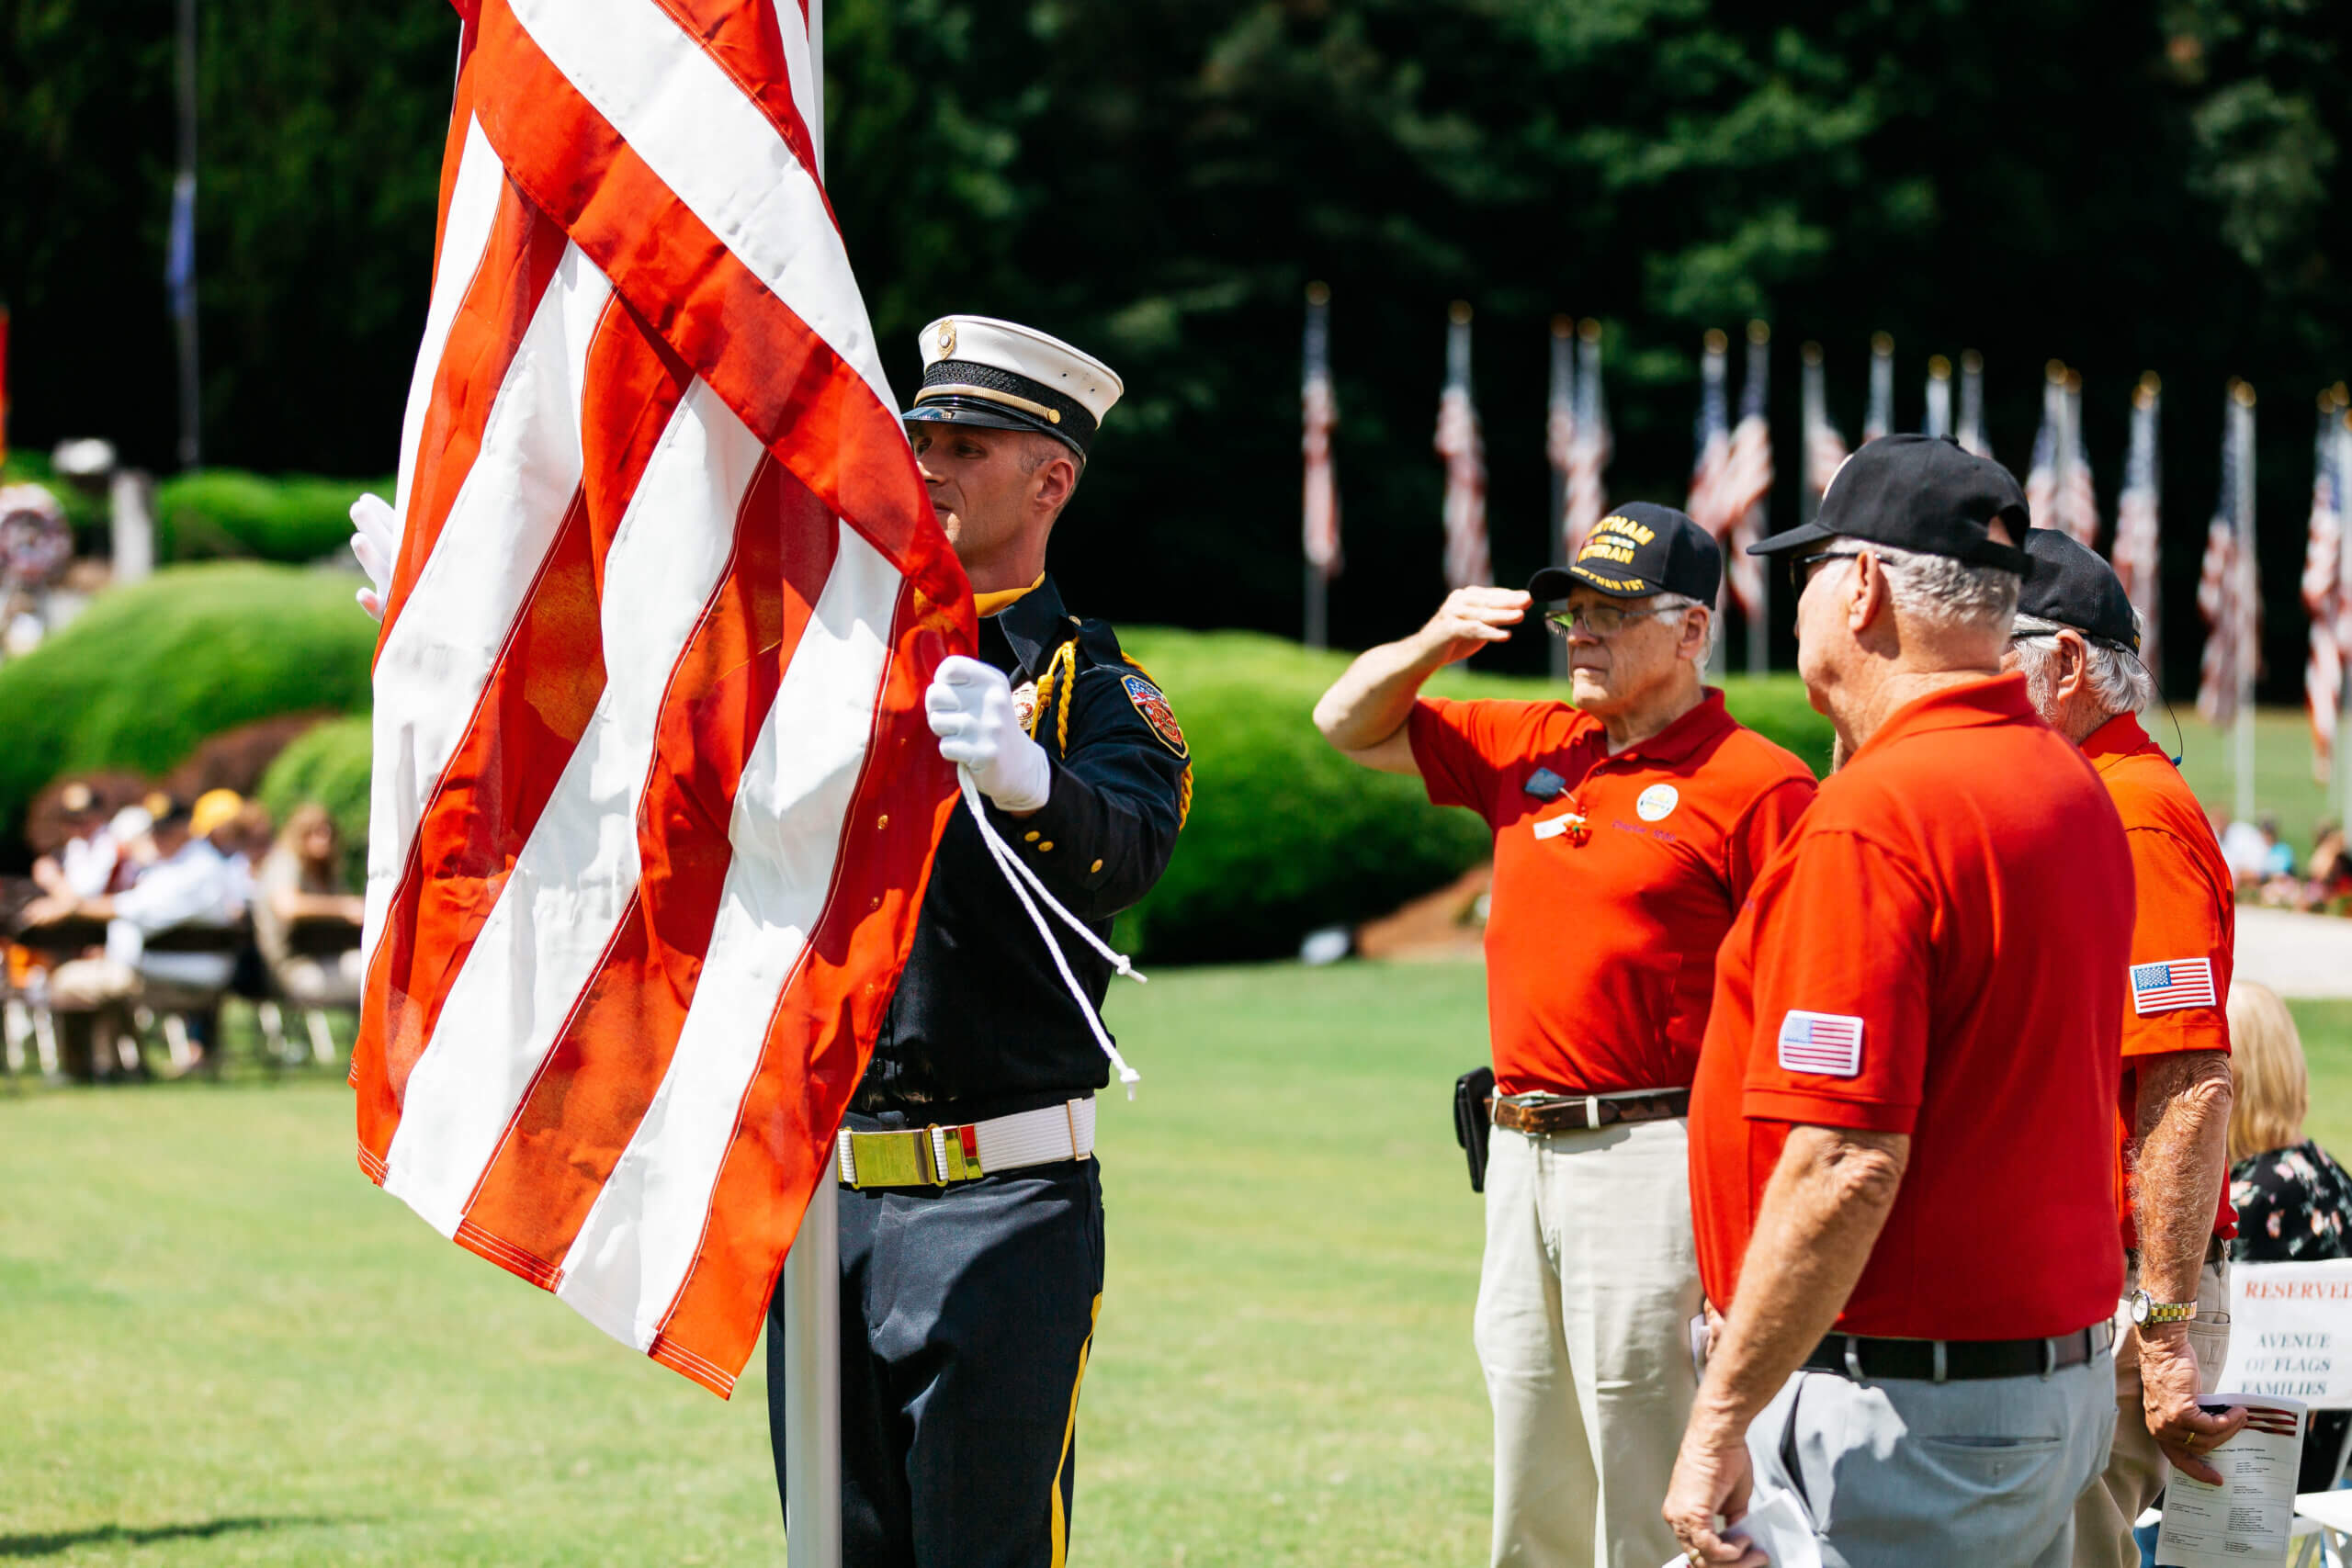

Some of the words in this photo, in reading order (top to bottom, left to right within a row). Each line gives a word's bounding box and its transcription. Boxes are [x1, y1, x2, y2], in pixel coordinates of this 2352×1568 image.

[1577, 544, 1634, 565] ETERAN
[2256, 1333, 2331, 1348] AVENUE
[2245, 1359, 2266, 1372] OF
[2273, 1359, 2331, 1372] FLAGS
[2242, 1381, 2326, 1395] FAMILIES
